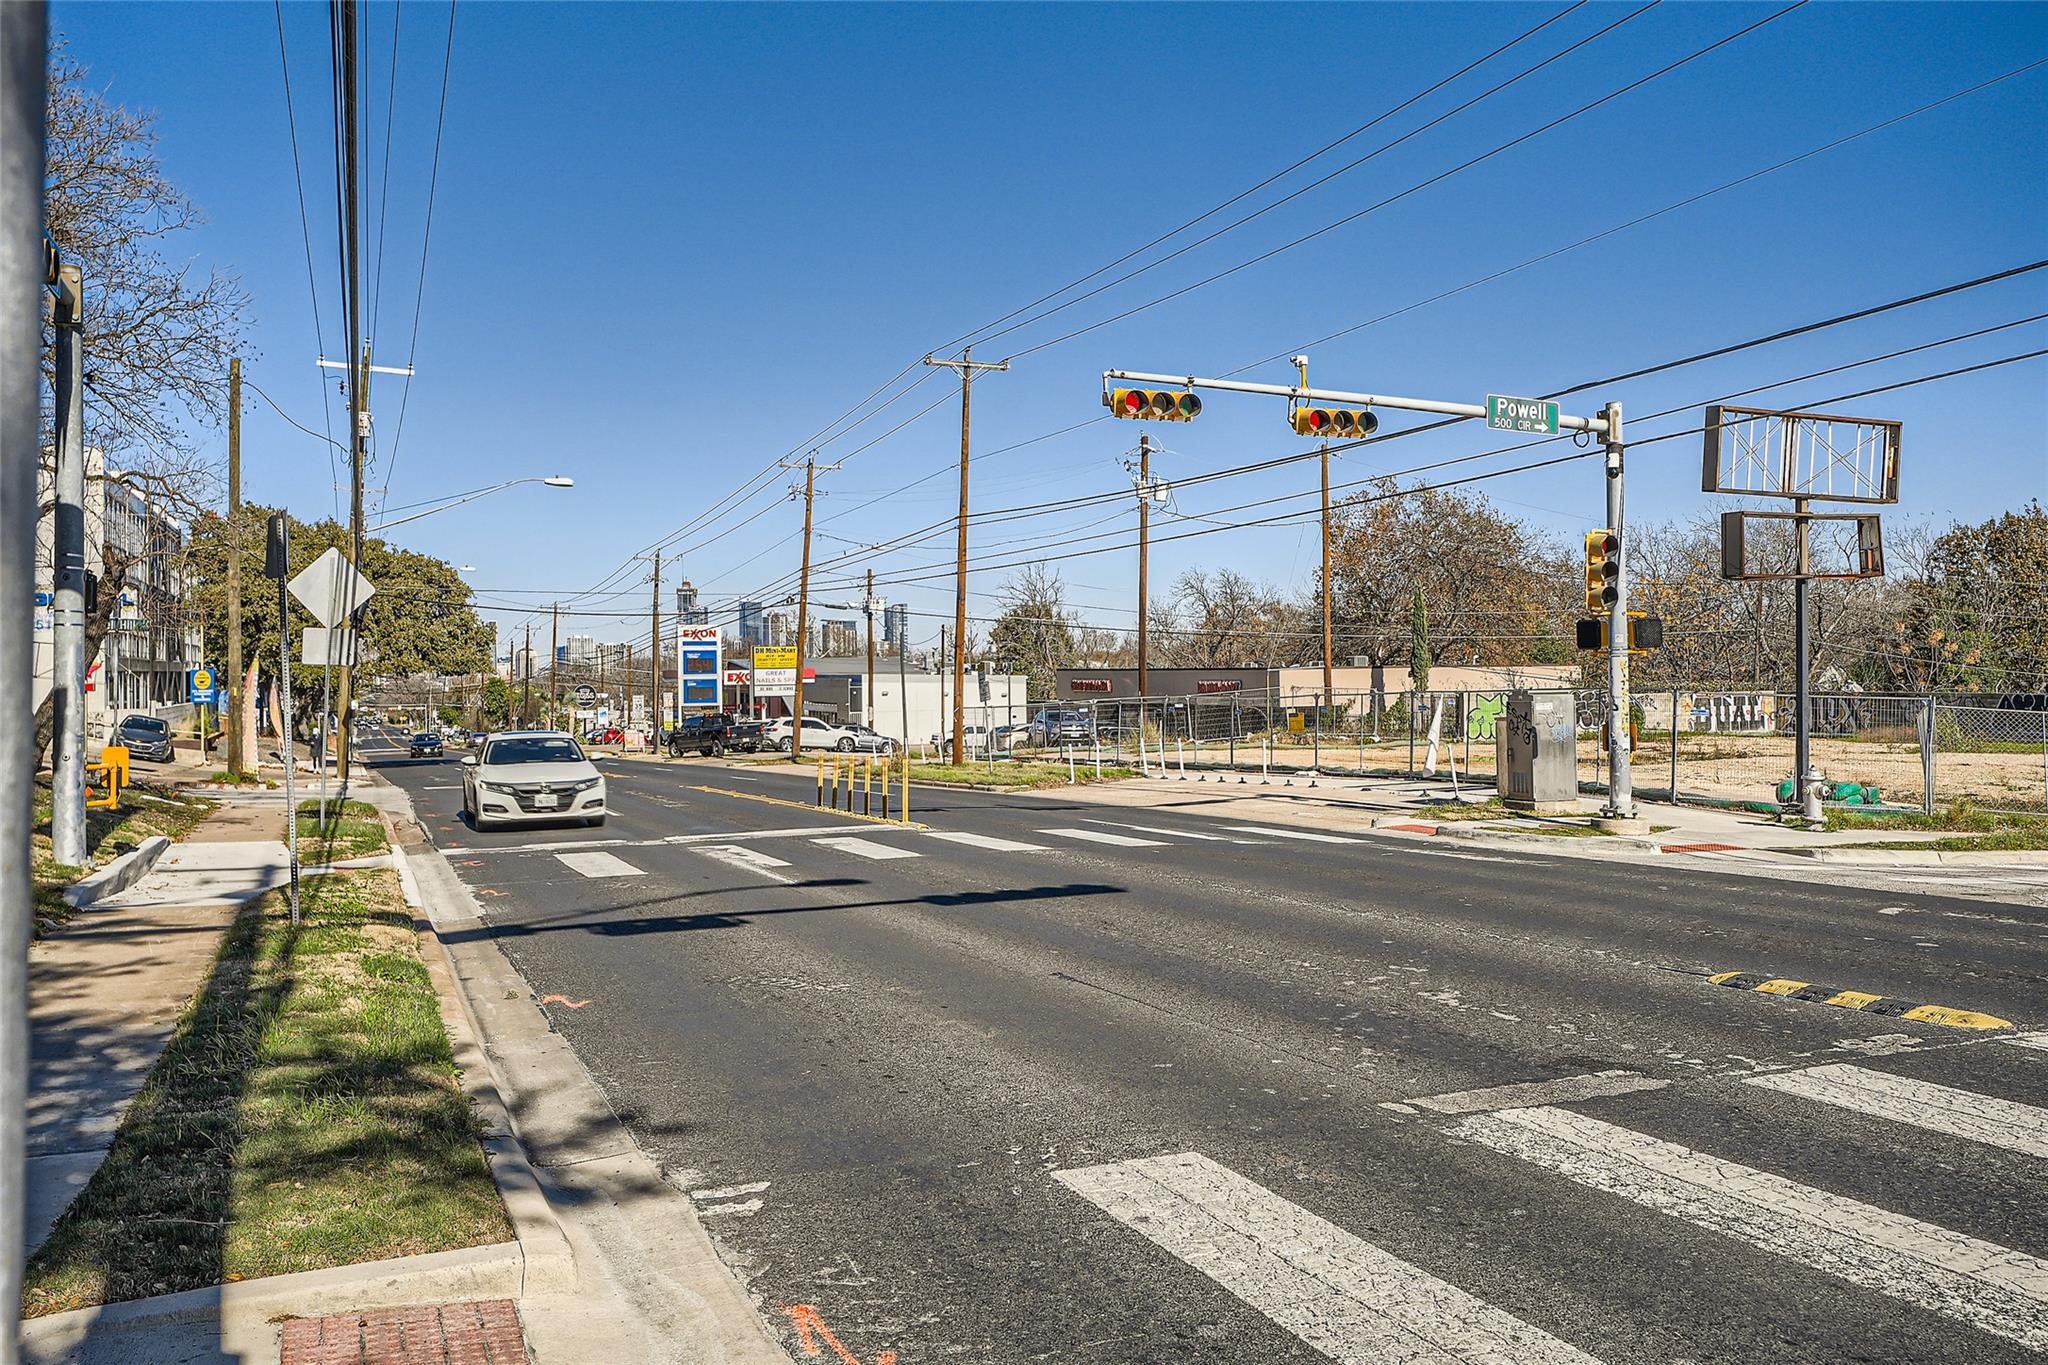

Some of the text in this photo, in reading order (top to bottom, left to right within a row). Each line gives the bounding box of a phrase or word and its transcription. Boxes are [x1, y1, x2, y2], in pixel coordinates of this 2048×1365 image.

[1497, 398, 1547, 420] Powell
[1495, 418, 1531, 431] 500 CIR
[683, 629, 717, 641] EXXON
